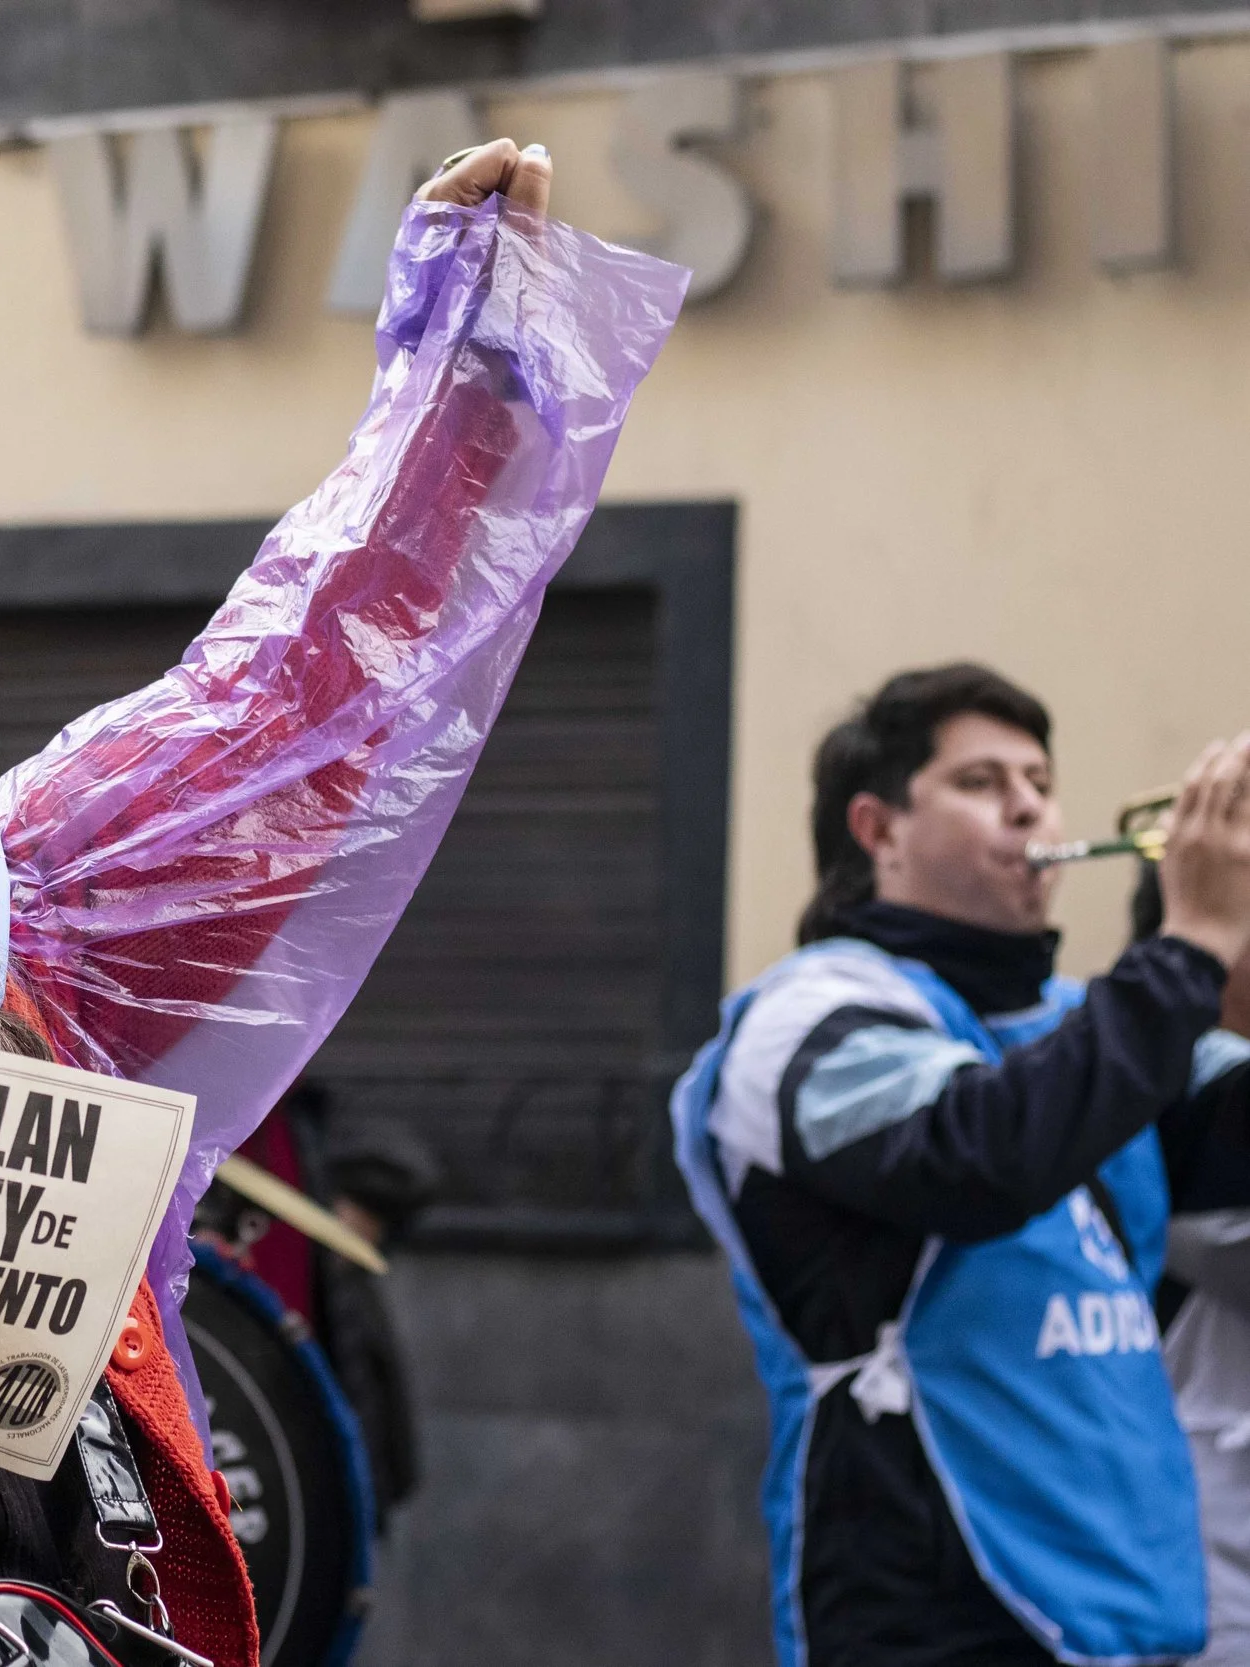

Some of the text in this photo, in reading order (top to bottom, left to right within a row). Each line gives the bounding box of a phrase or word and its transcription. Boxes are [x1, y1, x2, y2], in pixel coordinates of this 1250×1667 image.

[32, 1210, 77, 1249] DE
[7, 1352, 51, 1361] TRABAJADOR
[51, 1356, 60, 1366] DE
[6, 1421, 52, 1440] NACIONALES
